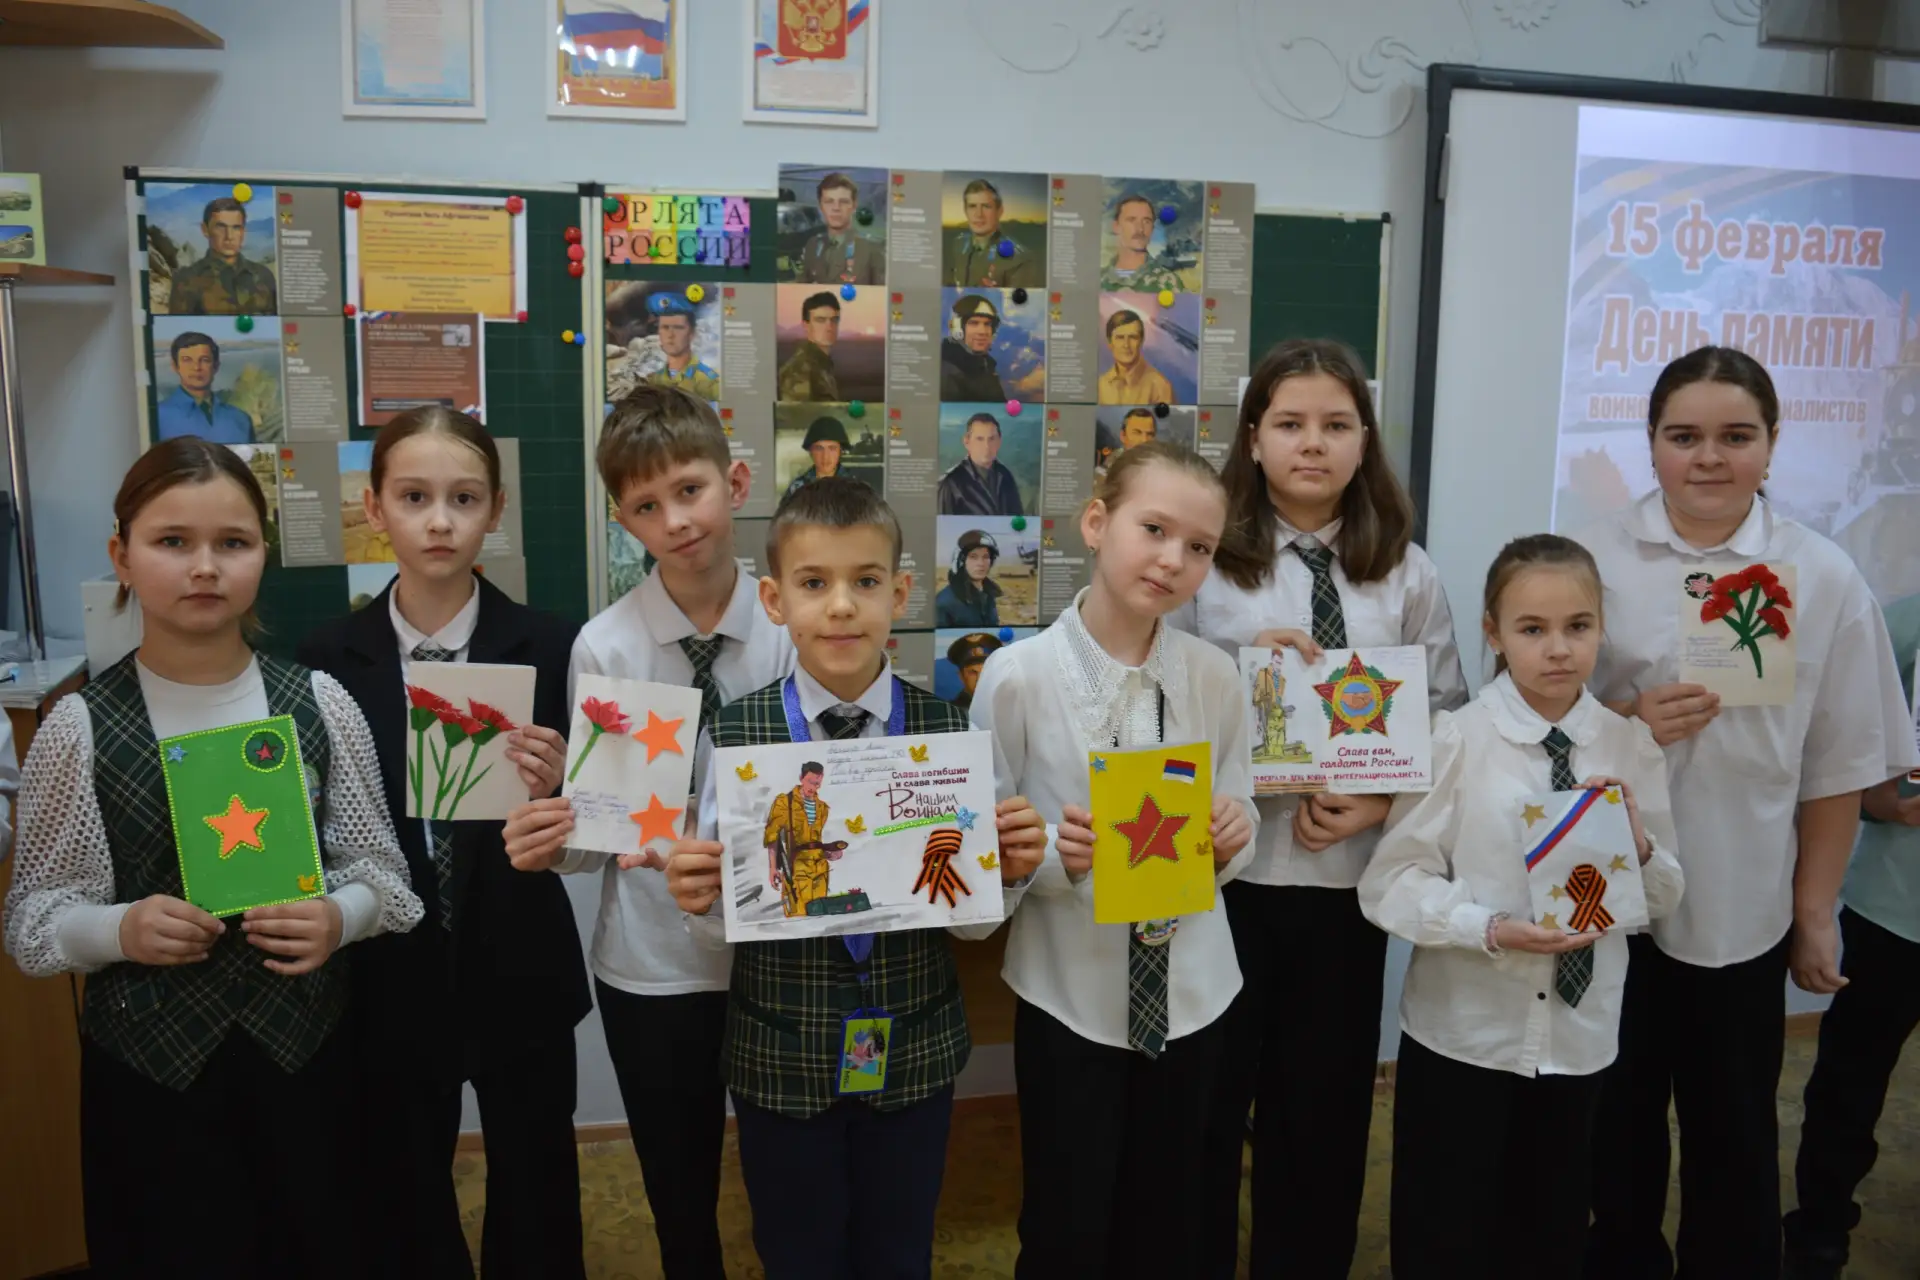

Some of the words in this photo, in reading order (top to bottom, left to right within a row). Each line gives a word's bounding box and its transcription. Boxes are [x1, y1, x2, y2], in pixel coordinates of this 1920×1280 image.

[605, 199, 747, 226] ОРЛЯТА
[1606, 202, 1659, 256] 15
[1675, 201, 1885, 273] февраля
[608, 234, 748, 260] РОССИИ
[1594, 296, 1710, 374] День
[1720, 313, 1875, 370] памяти
[1337, 746, 1369, 757] Слава
[1372, 747, 1396, 757] вам,
[1320, 758, 1368, 769] солдаты
[1370, 757, 1414, 768] России!
[891, 770, 920, 779] Слава
[921, 767, 970, 778] погибшим
[903, 778, 931, 788] слава
[932, 776, 967, 786] живым
